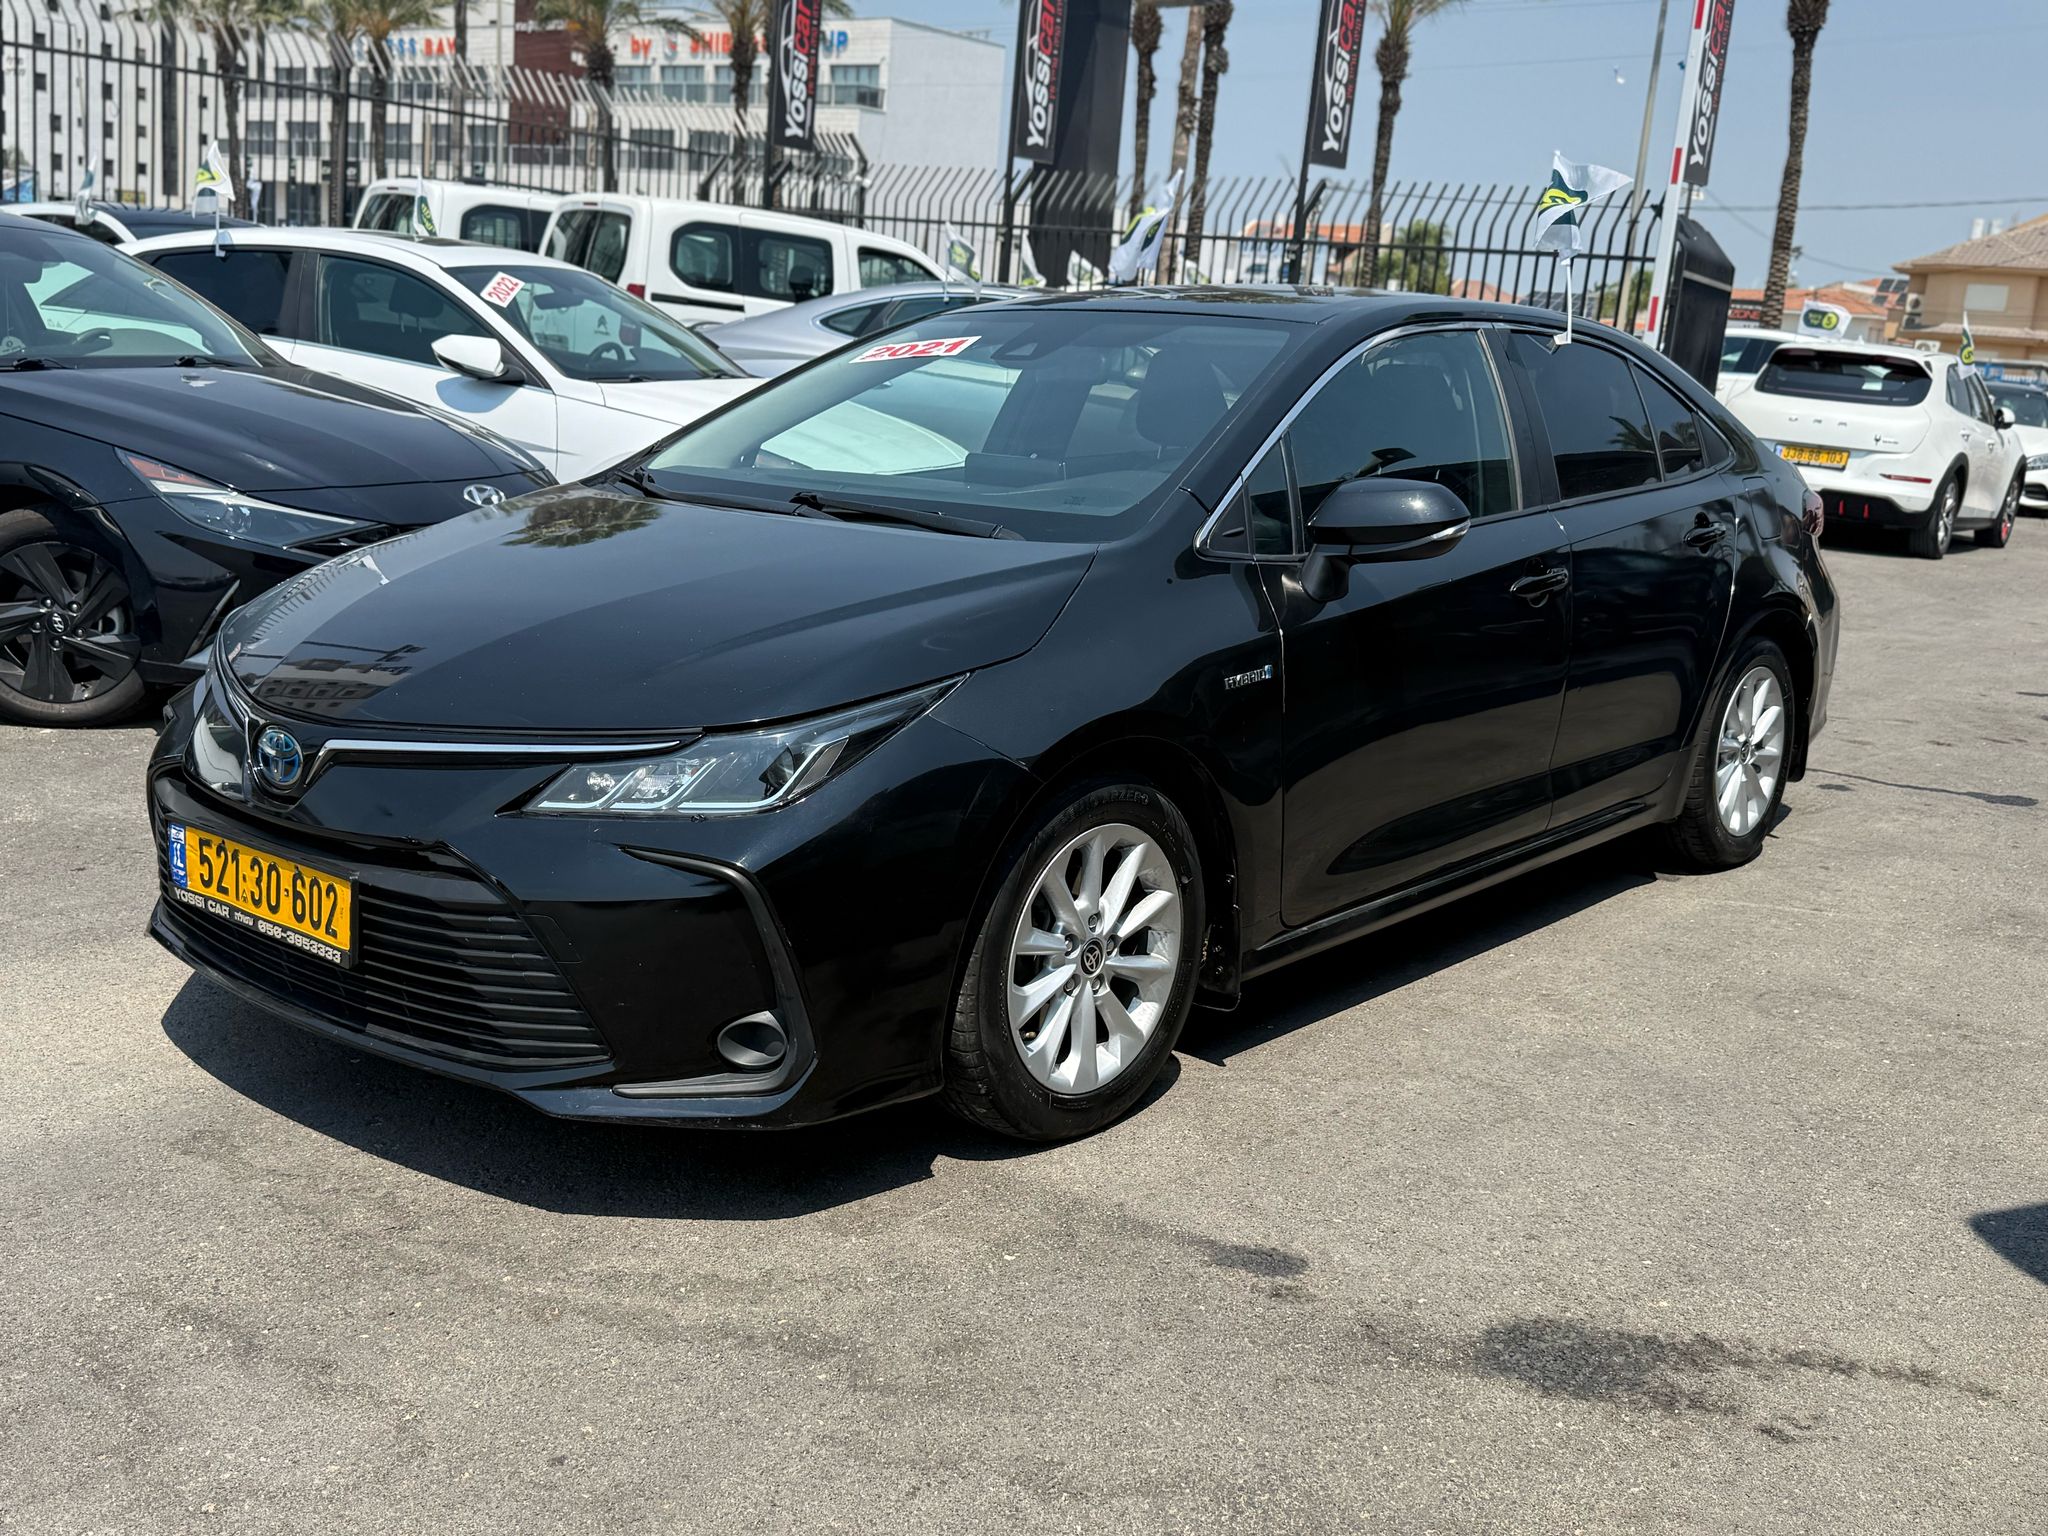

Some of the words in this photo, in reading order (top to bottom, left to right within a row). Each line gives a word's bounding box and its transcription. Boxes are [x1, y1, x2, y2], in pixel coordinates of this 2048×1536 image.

[488, 276, 519, 303] 2022
[860, 338, 970, 361] 2021
[174, 887, 206, 909] YOSSI
[207, 900, 230, 919] CAR
